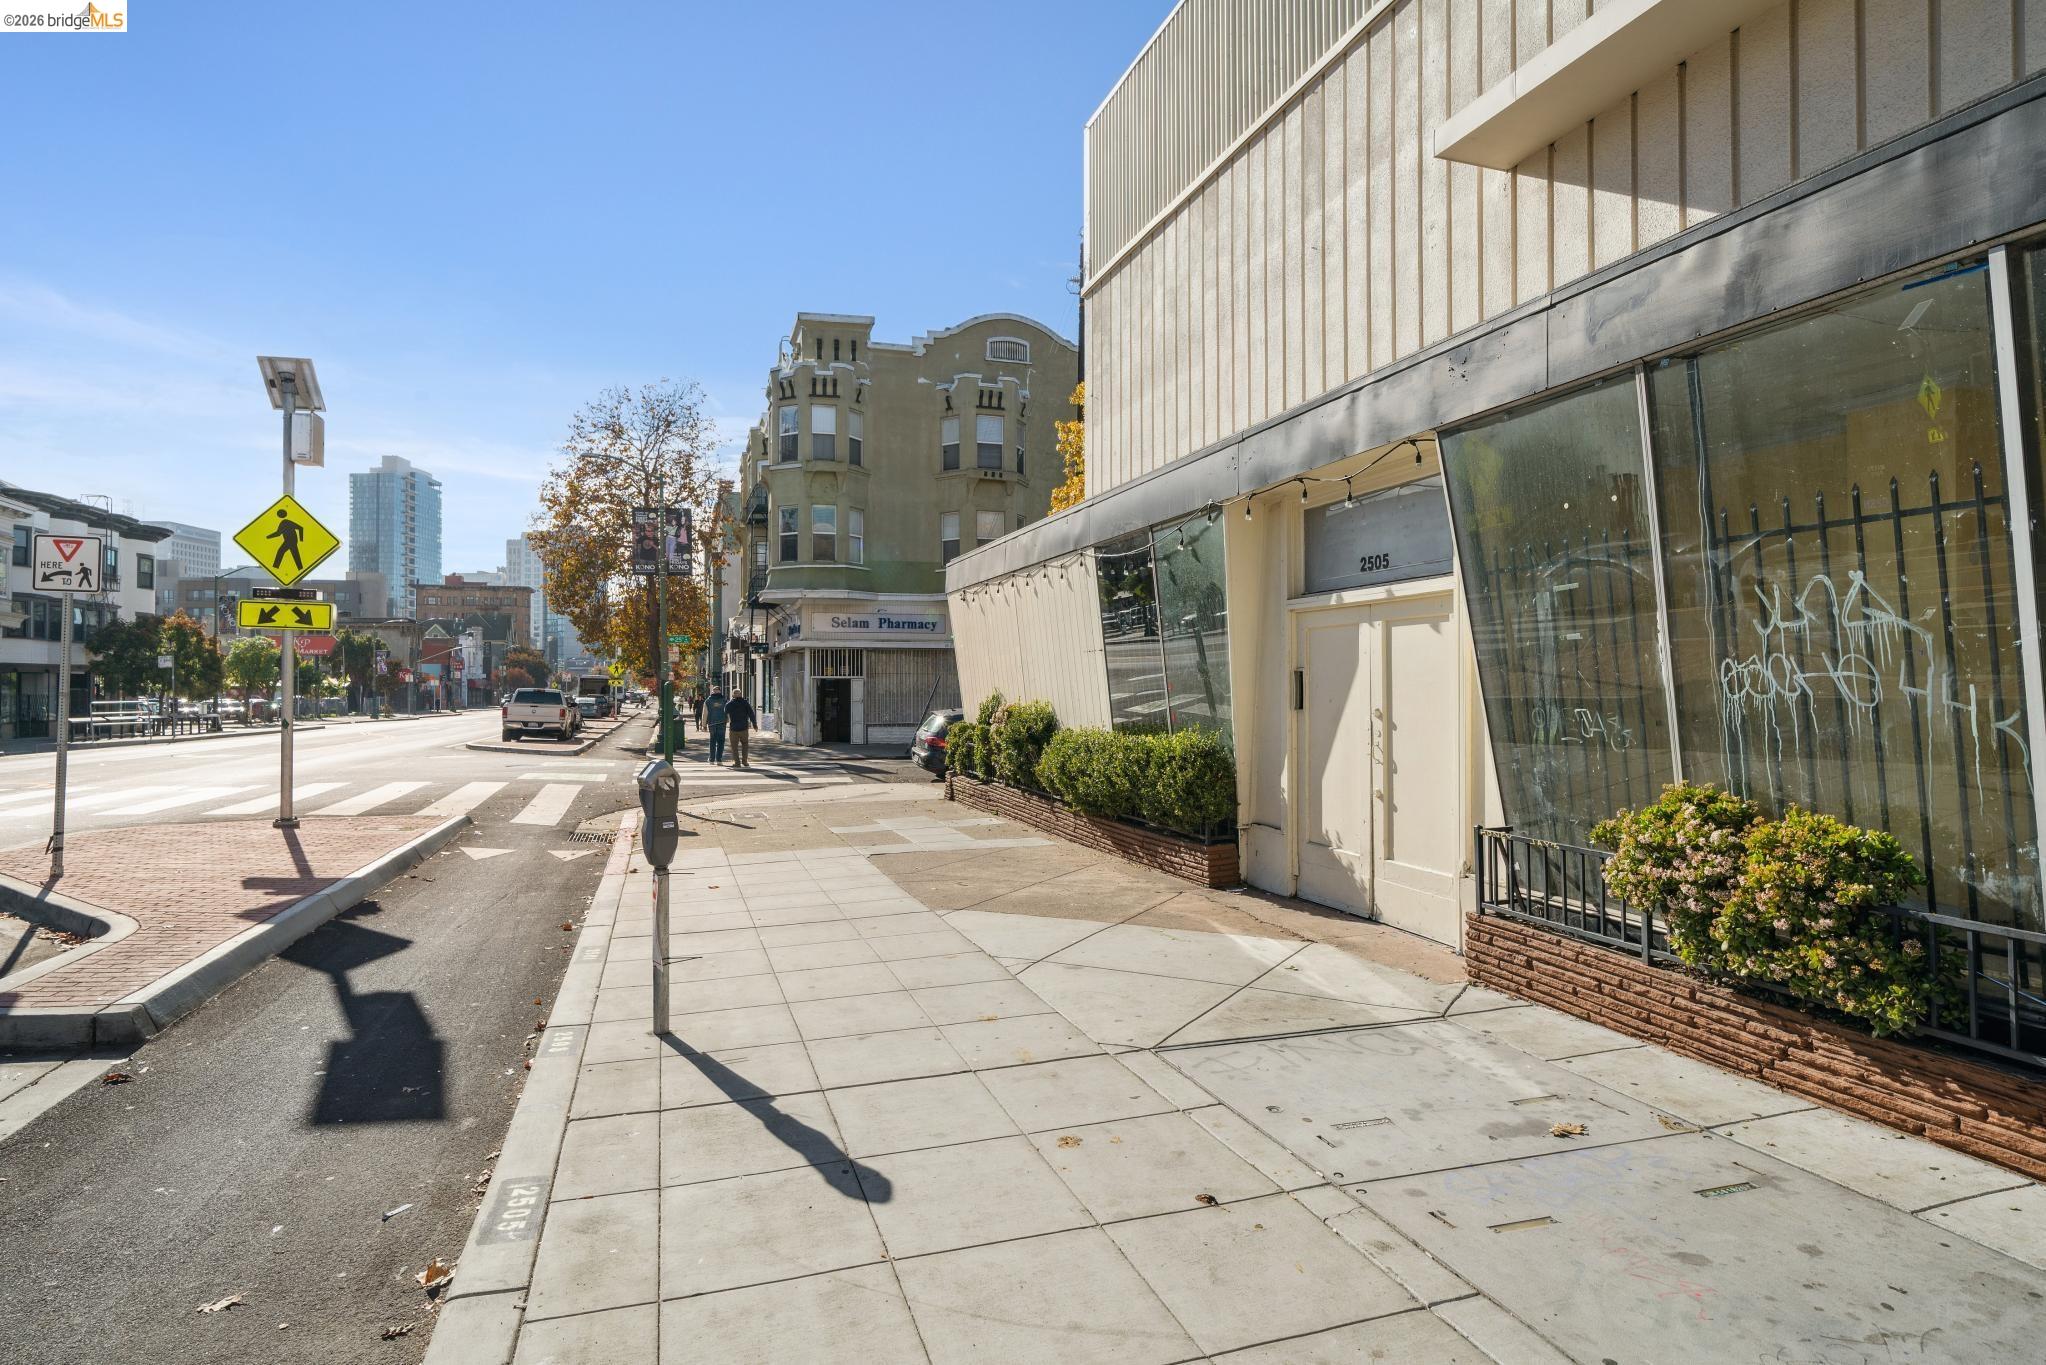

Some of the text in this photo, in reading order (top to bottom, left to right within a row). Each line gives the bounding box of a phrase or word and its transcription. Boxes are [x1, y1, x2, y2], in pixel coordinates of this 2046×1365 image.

[40, 561, 63, 569] HERE
[1360, 553, 1389, 572] 2505
[61, 577, 72, 586] TO
[831, 616, 937, 631] Selam Pharmacy
[497, 1186, 540, 1230] 2505
